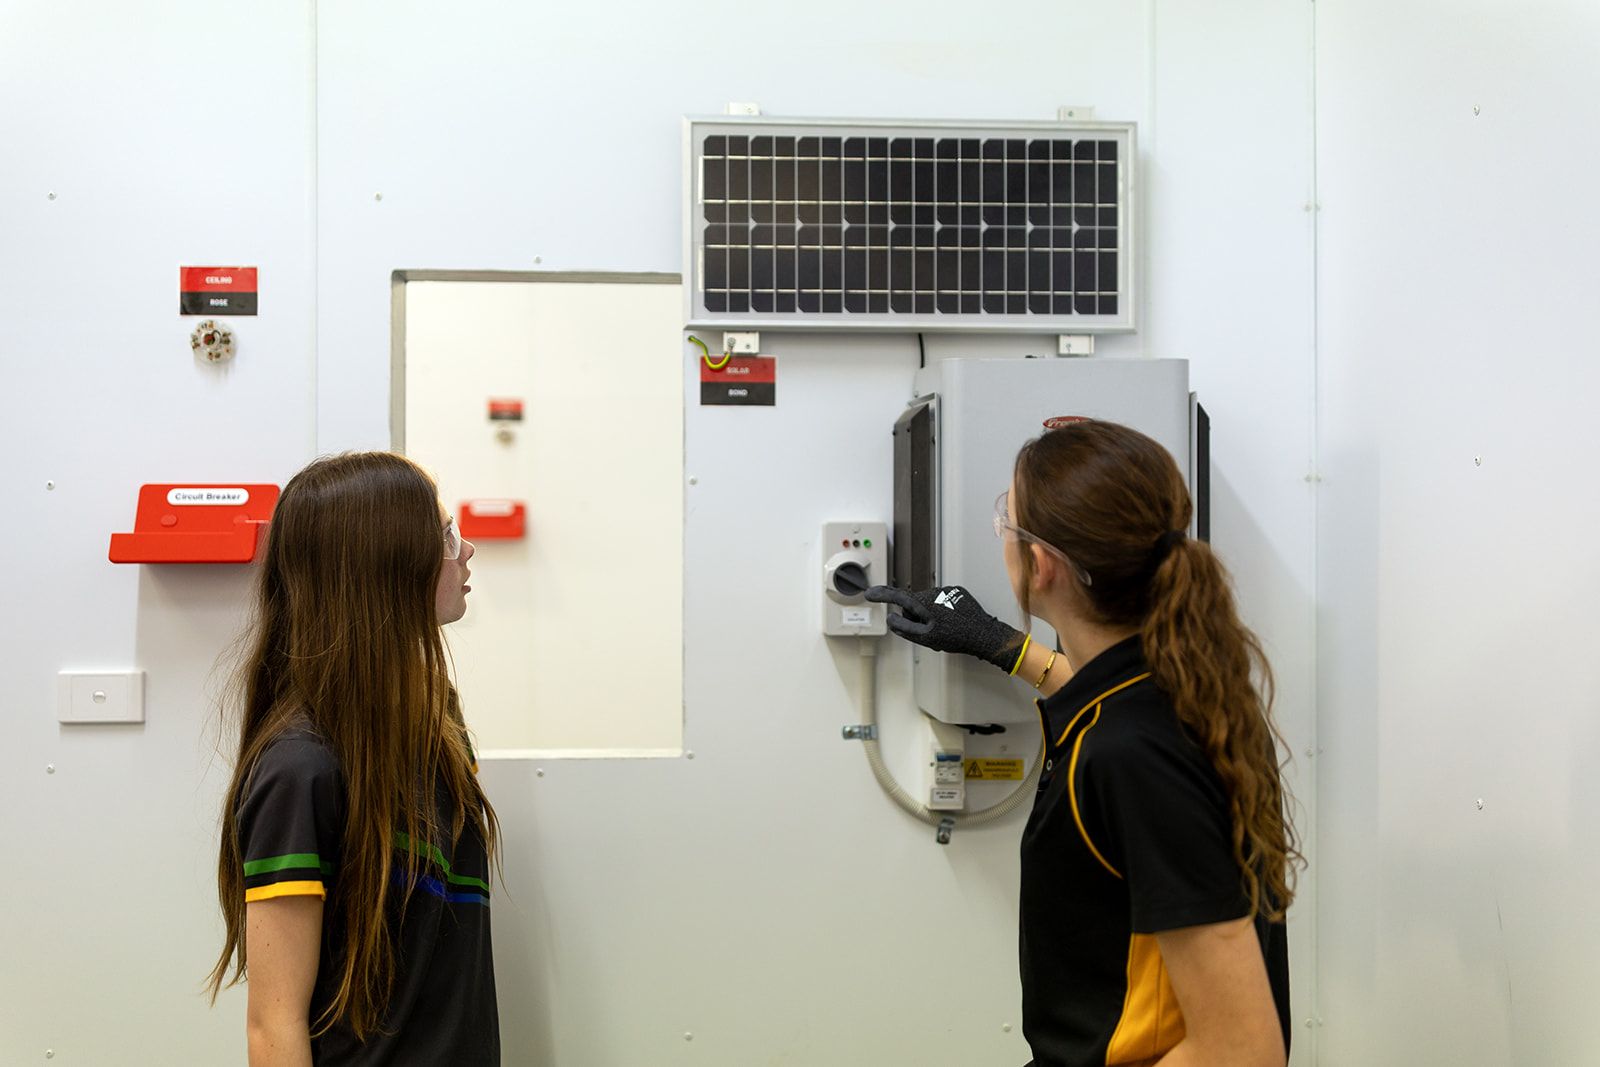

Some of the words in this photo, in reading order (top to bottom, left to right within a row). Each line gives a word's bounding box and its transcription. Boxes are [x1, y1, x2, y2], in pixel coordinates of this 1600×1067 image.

[728, 388, 748, 396] BOND
[175, 492, 204, 501] Circuit
[206, 492, 241, 501] Breaker
